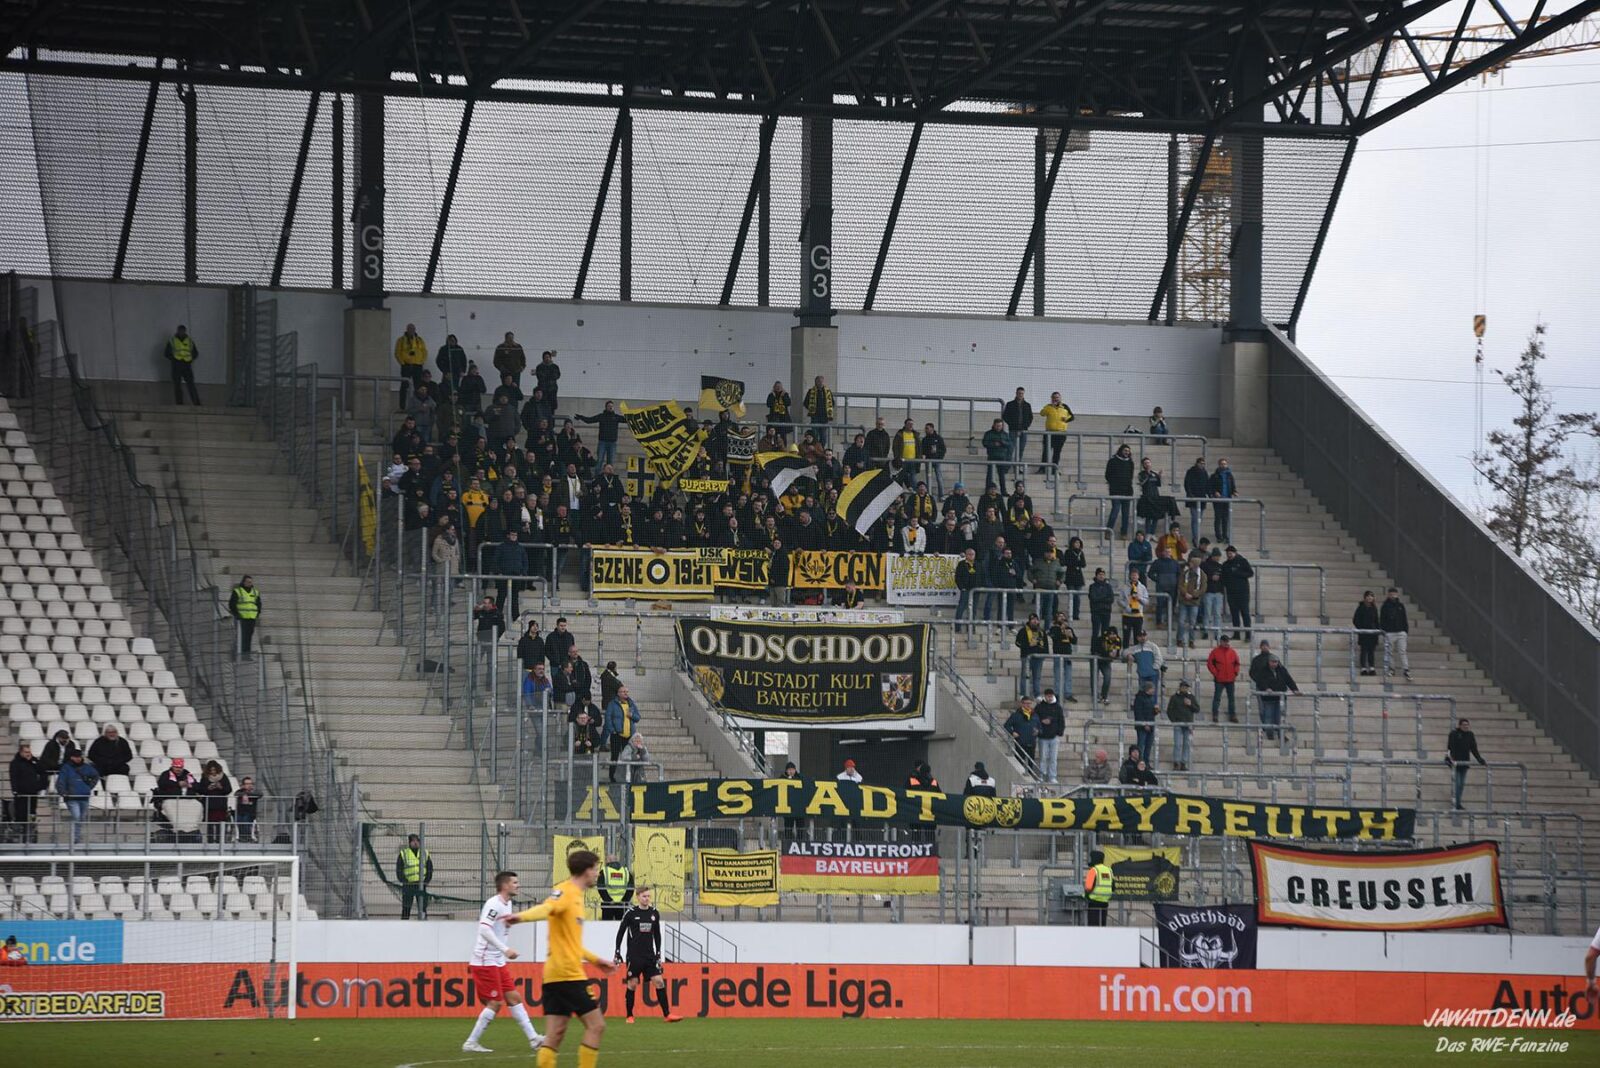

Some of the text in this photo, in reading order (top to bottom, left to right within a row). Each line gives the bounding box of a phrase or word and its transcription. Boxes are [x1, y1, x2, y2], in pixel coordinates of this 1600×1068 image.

[680, 479, 729, 492] SUPCREW
[699, 548, 723, 558] USK
[734, 549, 768, 559] SUPCRE
[594, 557, 709, 585] SZENE 1921
[719, 554, 767, 582] WSK
[690, 625, 914, 664] OLDSCHDOD
[731, 669, 874, 689] ALTSTADT KULT
[756, 690, 847, 707] BAYREUTH
[575, 778, 947, 821] ALTSTADT
[1039, 797, 1399, 841] BAYREUTH
[788, 843, 932, 857] ALTSTADTFRONT
[714, 869, 767, 877] BAYREUTH
[816, 860, 908, 874] BAYREUTH
[1287, 872, 1474, 910] CREUSSEN
[0, 936, 96, 961] en.de
[697, 966, 791, 1018] jede
[806, 968, 903, 1018] Liga.
[1100, 973, 1252, 1013] ifm.com
[1491, 981, 1600, 1020] Auto
